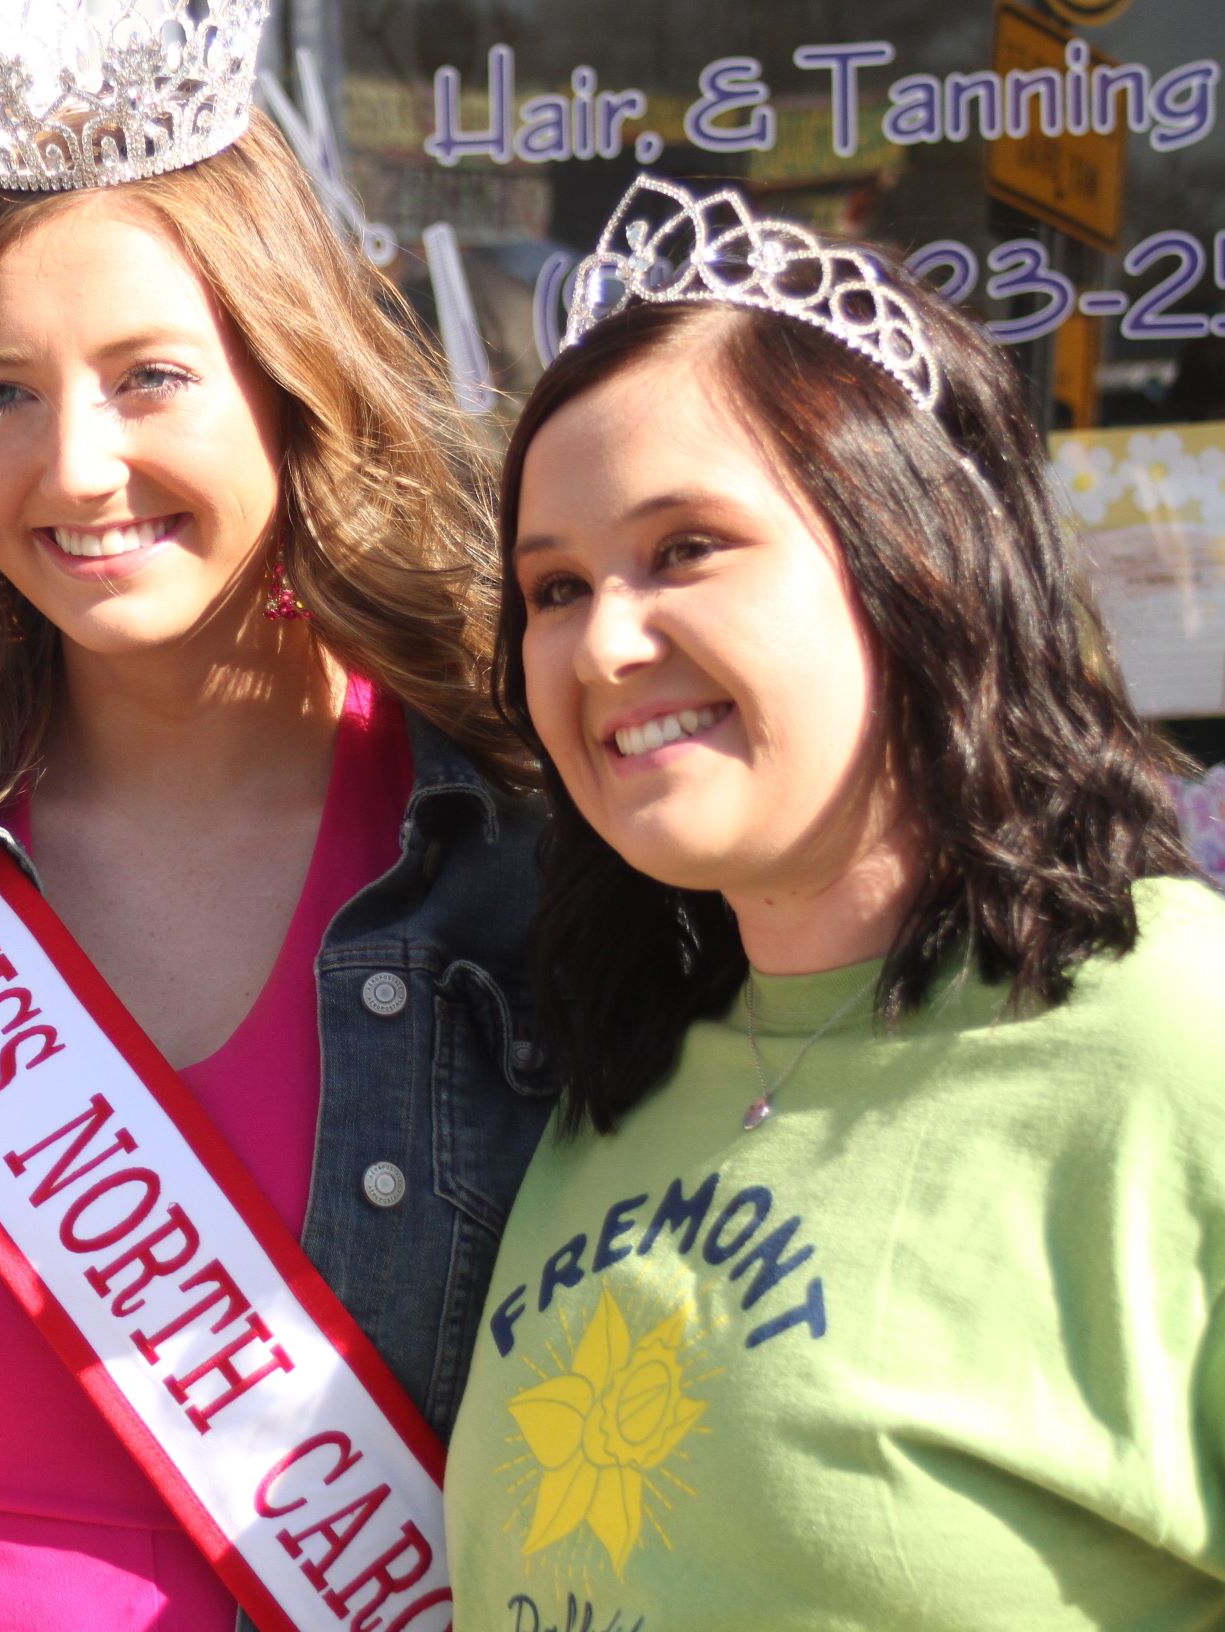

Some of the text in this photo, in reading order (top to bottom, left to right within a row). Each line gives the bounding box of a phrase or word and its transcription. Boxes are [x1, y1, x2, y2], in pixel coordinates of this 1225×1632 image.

[683, 56, 776, 152] &
[793, 38, 1220, 157] Tanning
[3, 1093, 296, 1436] NORTH
[489, 1172, 827, 1358] FREMONT
